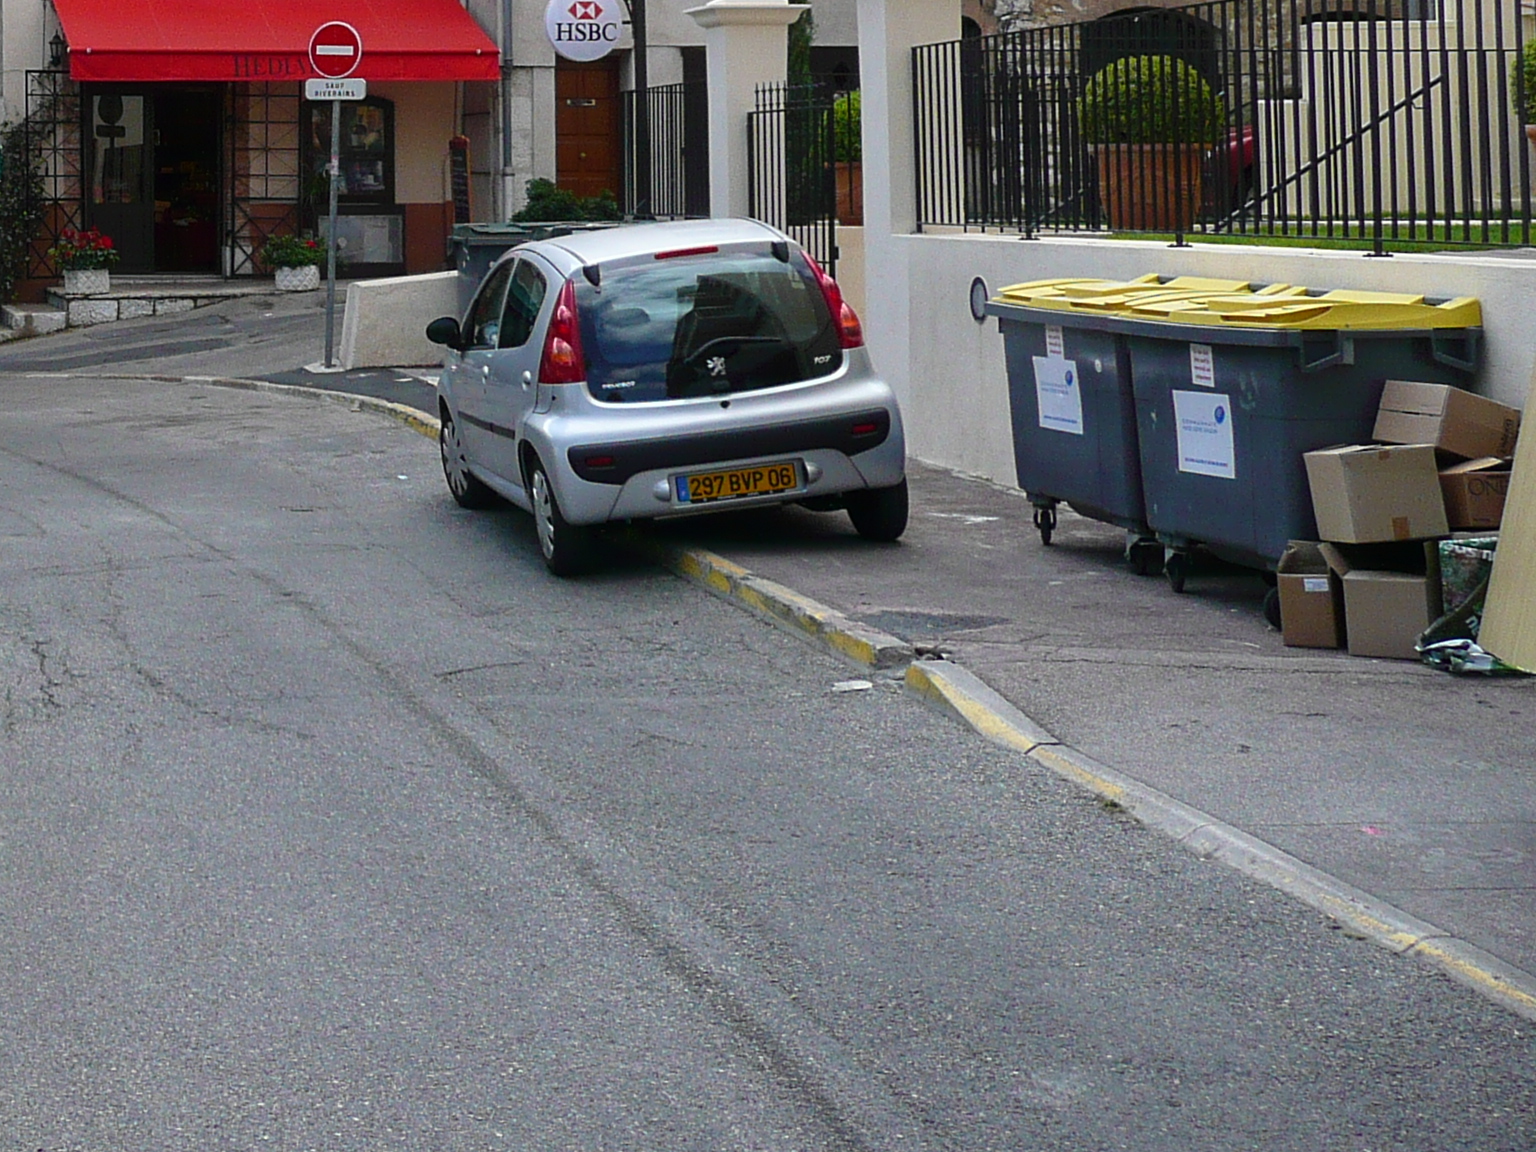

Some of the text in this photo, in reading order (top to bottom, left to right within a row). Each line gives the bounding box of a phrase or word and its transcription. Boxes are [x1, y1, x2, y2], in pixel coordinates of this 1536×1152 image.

[555, 22, 618, 42] HSBC
[814, 355, 831, 365] 107
[602, 380, 636, 389] PEUGEOT
[690, 467, 792, 497] 297 BVP 06
